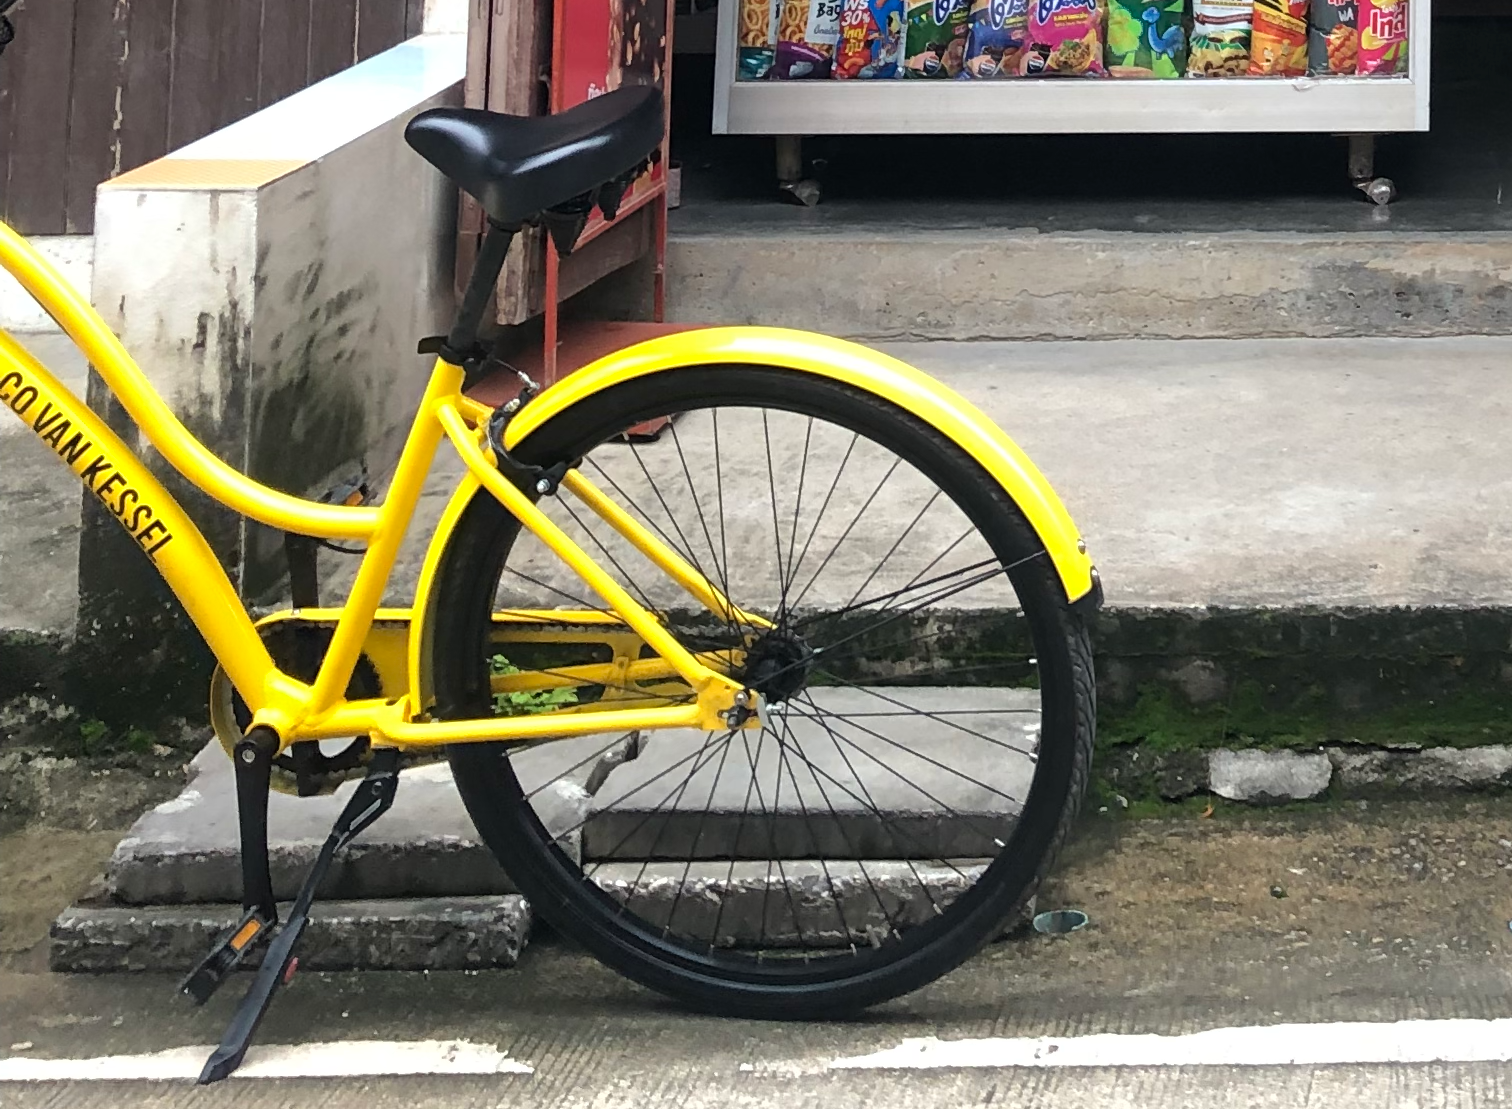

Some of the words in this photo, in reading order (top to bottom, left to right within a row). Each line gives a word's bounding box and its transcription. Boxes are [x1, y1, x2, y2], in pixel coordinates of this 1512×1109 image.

[816, 3, 841, 23] Bag
[841, 10, 871, 27] 30%
[0, 371, 39, 415] CO
[33, 402, 93, 466] VAN
[81, 454, 174, 564] KESSEL
